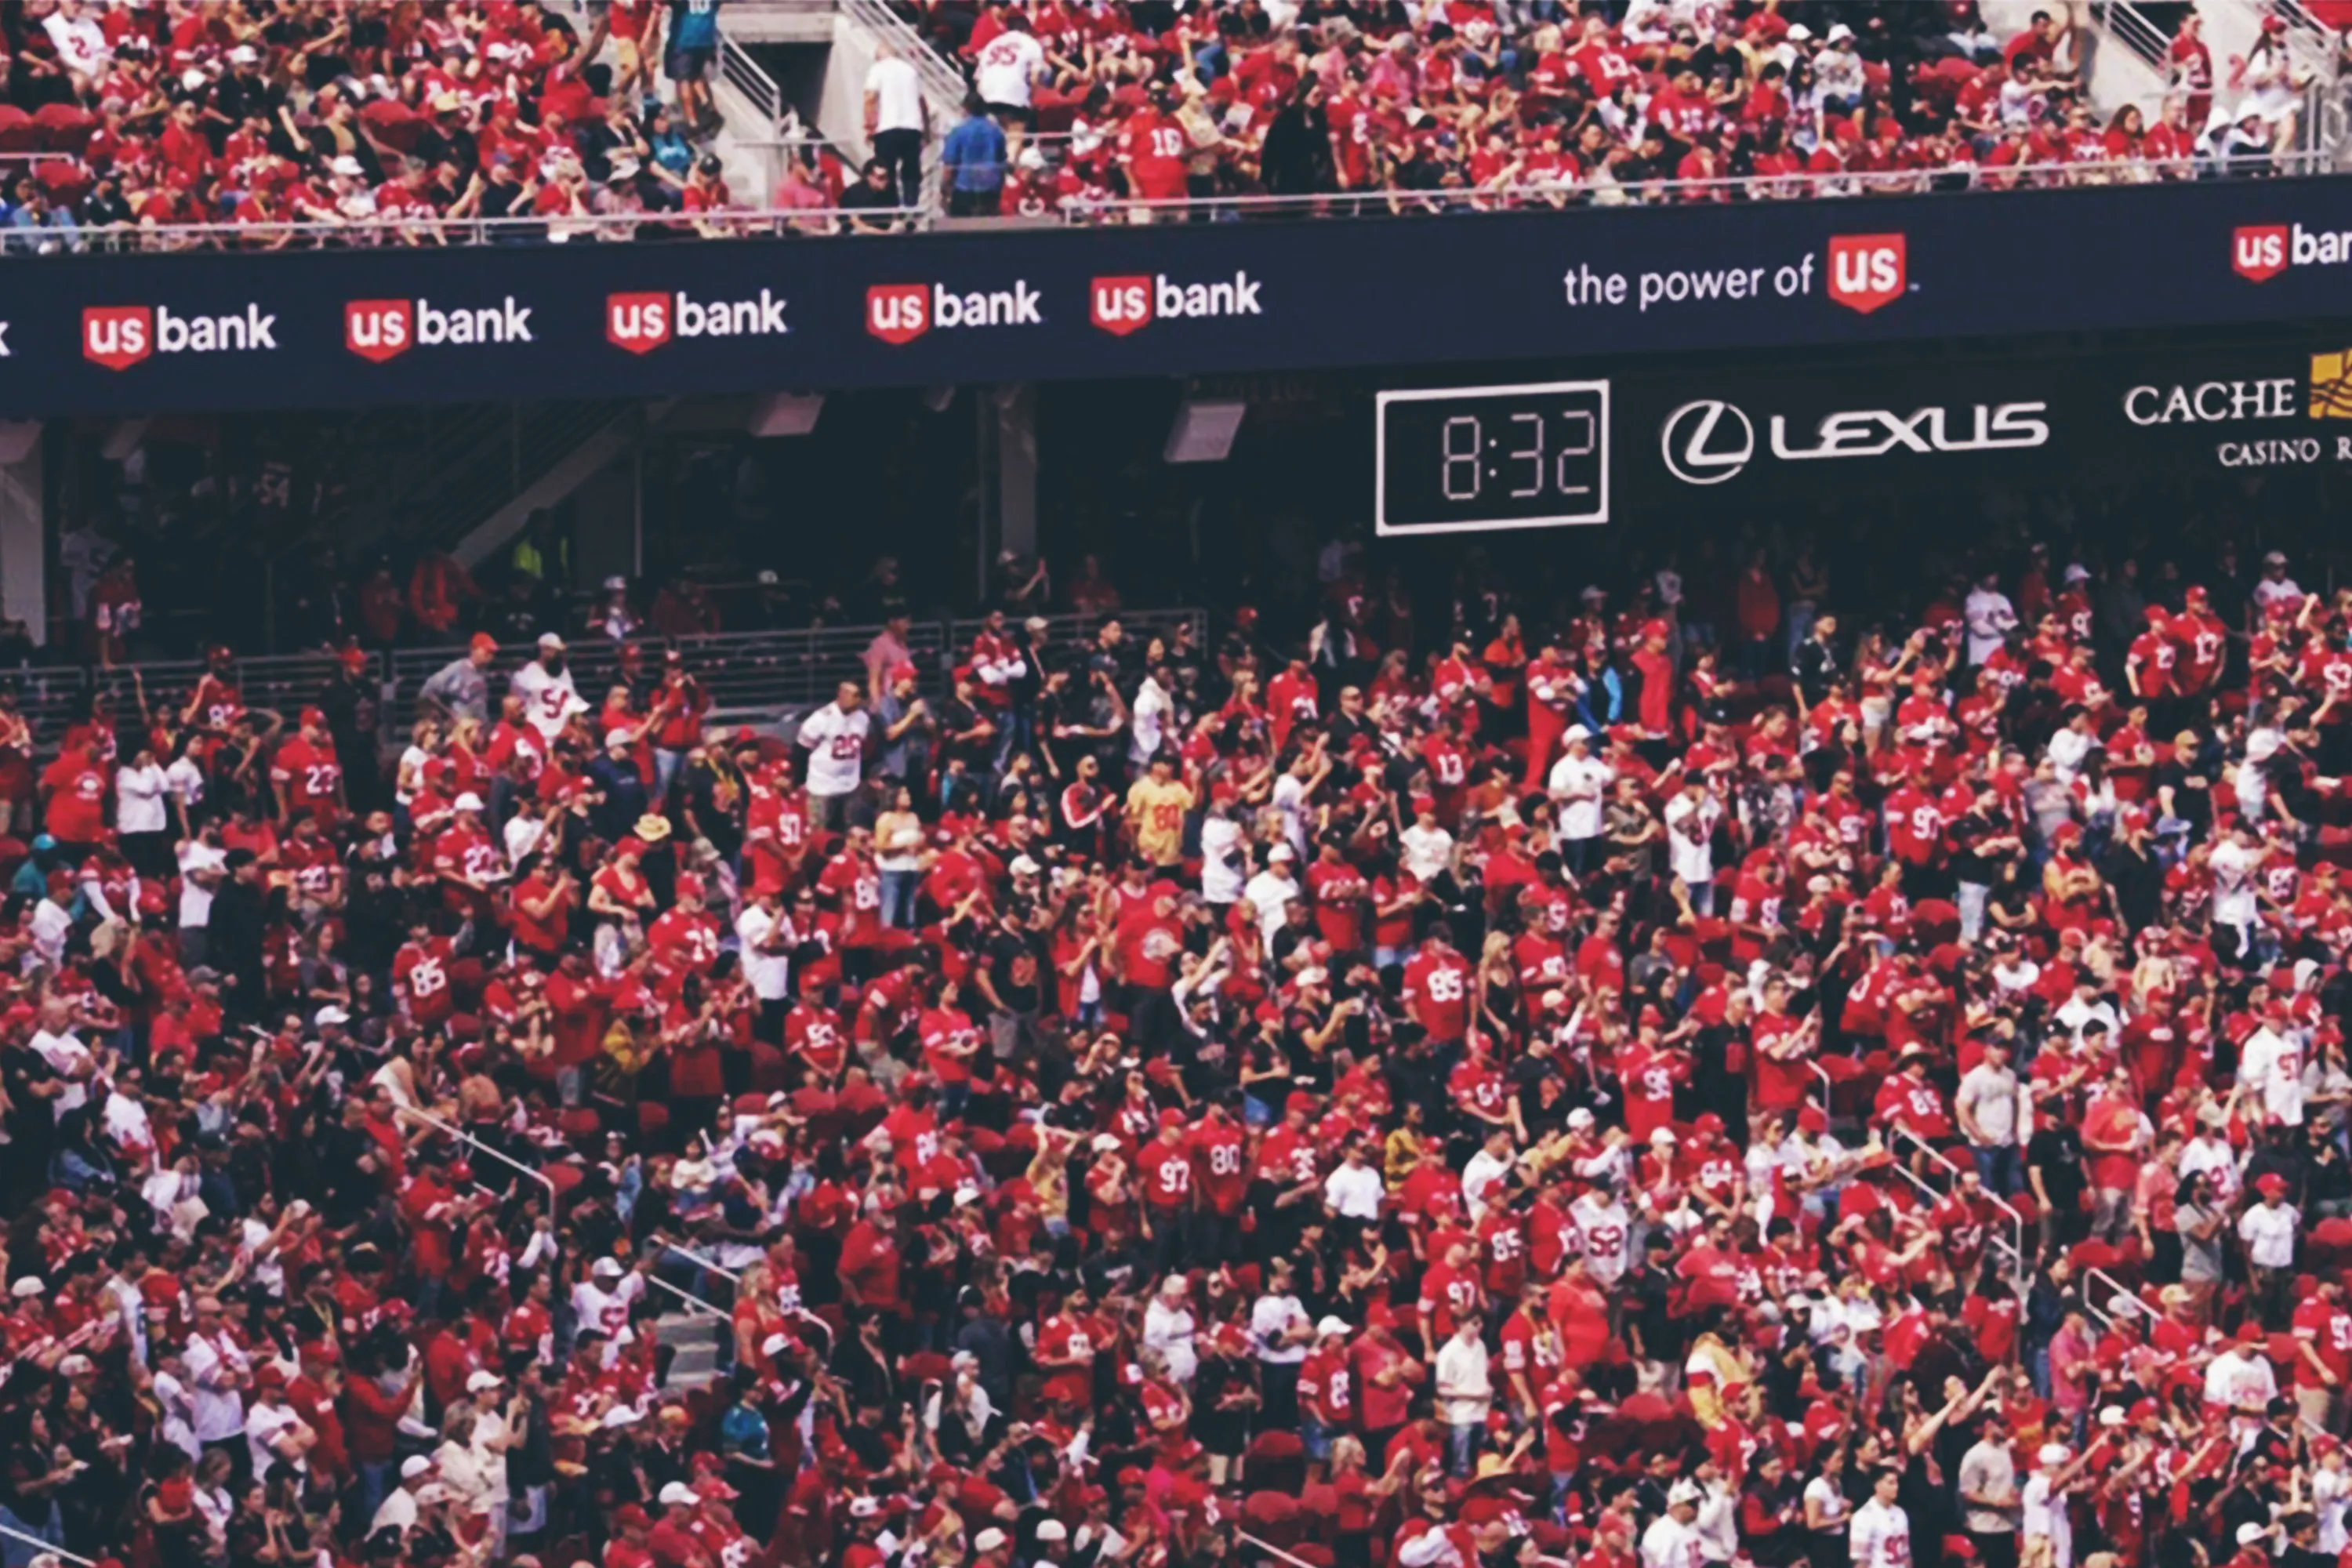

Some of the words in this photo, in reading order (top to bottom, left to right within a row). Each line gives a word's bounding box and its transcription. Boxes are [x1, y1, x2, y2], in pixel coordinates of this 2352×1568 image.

[2238, 234, 2282, 268] us
[873, 295, 924, 330] us
[934, 279, 1042, 328] bank
[1097, 285, 1147, 321] us
[1156, 270, 1262, 318] bank
[1563, 263, 1628, 306] the
[1639, 268, 1766, 312] power
[1774, 252, 1814, 296] of
[1835, 248, 1898, 293] us
[89, 318, 145, 354] us
[157, 302, 277, 352] bank
[351, 310, 405, 347] us
[417, 296, 532, 345] bank
[612, 303, 665, 339] us
[676, 288, 788, 337] bank
[2124, 379, 2296, 426] CACHE
[1443, 410, 1595, 500] 8:32
[1769, 401, 2050, 460] LEXUS
[2218, 438, 2321, 467] CASINO
